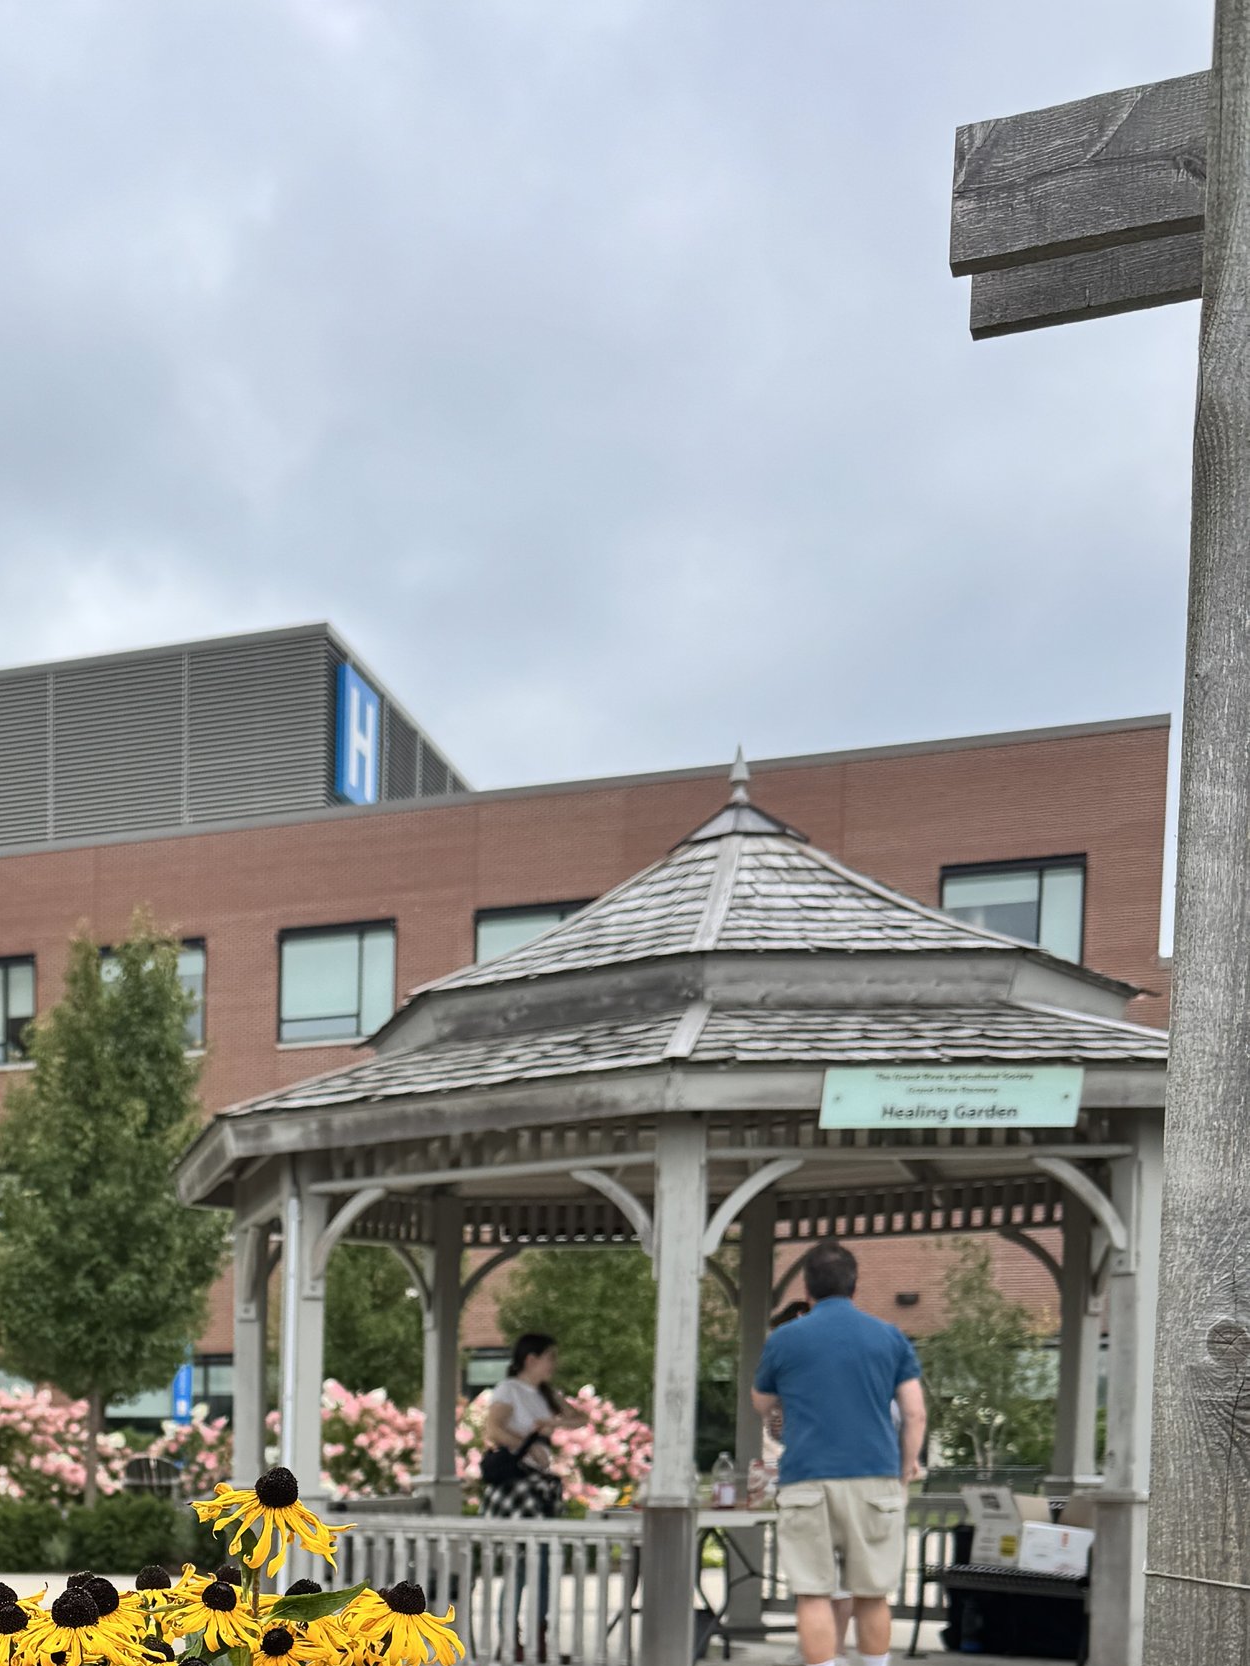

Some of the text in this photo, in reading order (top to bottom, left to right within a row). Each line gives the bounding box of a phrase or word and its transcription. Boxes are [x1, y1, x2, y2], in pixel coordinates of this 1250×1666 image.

[348, 686, 375, 804] H
[881, 1104, 1018, 1122] Healing Garden
